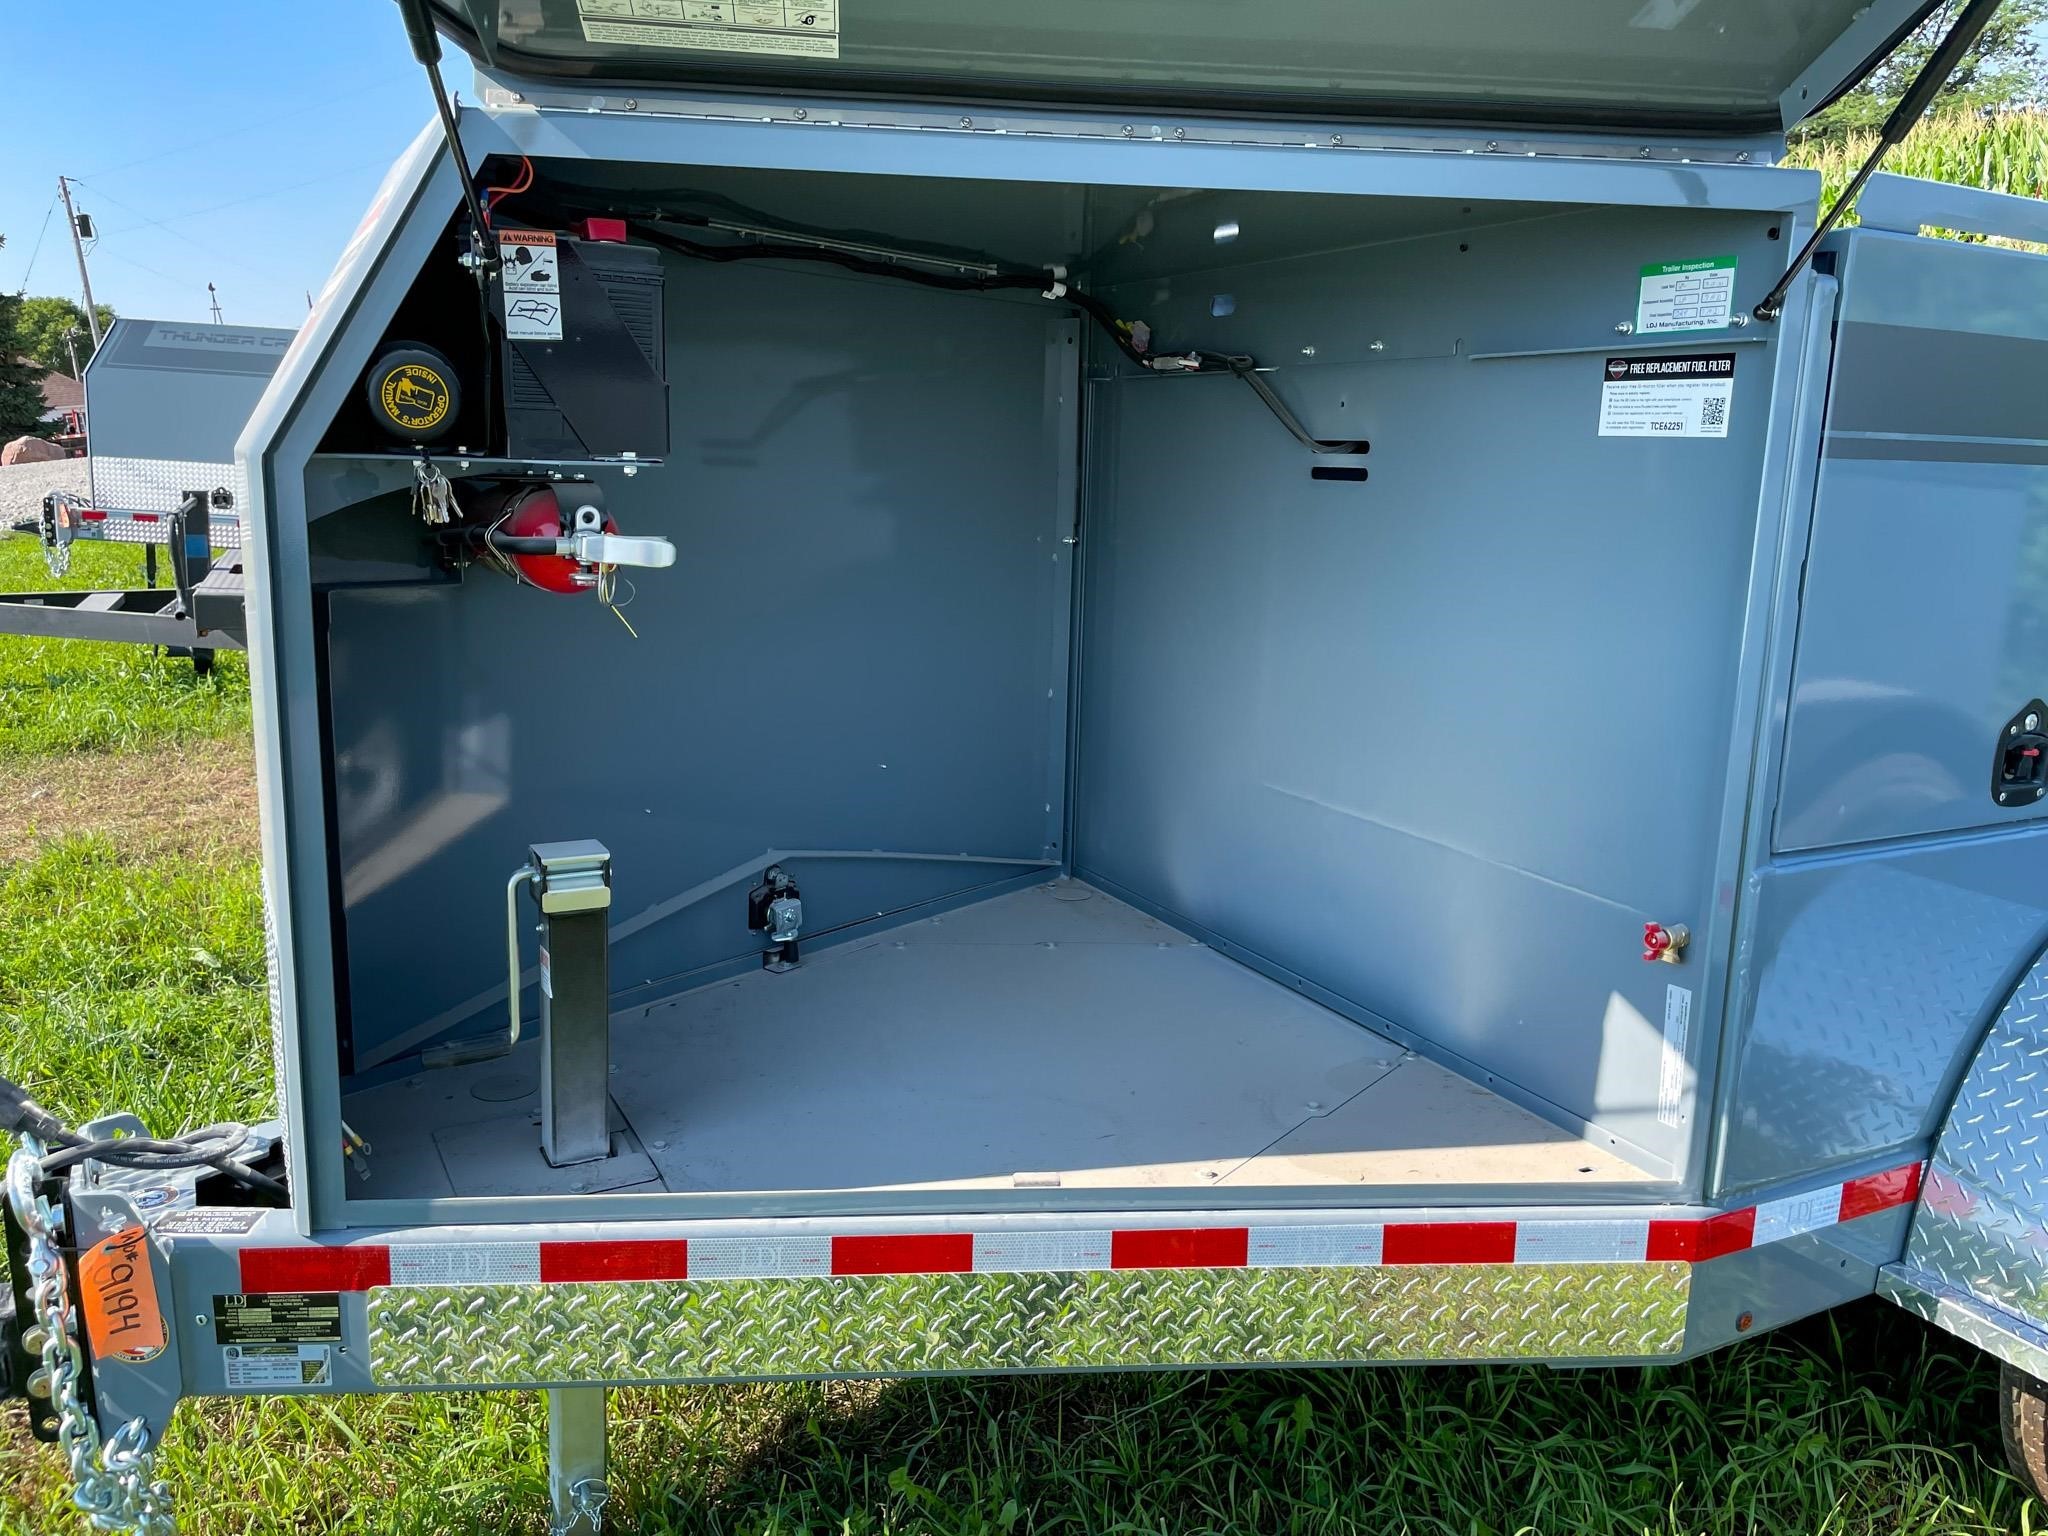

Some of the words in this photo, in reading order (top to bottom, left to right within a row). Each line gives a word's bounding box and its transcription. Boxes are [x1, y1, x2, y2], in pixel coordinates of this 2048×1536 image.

[513, 231, 554, 244] WARNING
[1662, 265, 1681, 273] Trailer
[1682, 261, 1715, 272] Inspection
[1658, 319, 1705, 328] Manufacturing,
[160, 329, 256, 346] THUNDER
[1629, 363, 1646, 375] FREE
[1645, 361, 1692, 374] REPLACEMENT
[1691, 360, 1708, 373] FUEL
[1708, 359, 1731, 372] FILTER
[404, 368, 438, 384] INSIDE
[385, 381, 401, 417] MANUAL
[401, 394, 446, 426] OPERATOR'S
[1650, 421, 1684, 431] TCE62251
[98, 1263, 142, 1335] 9194
[224, 1294, 247, 1308] LDJ
